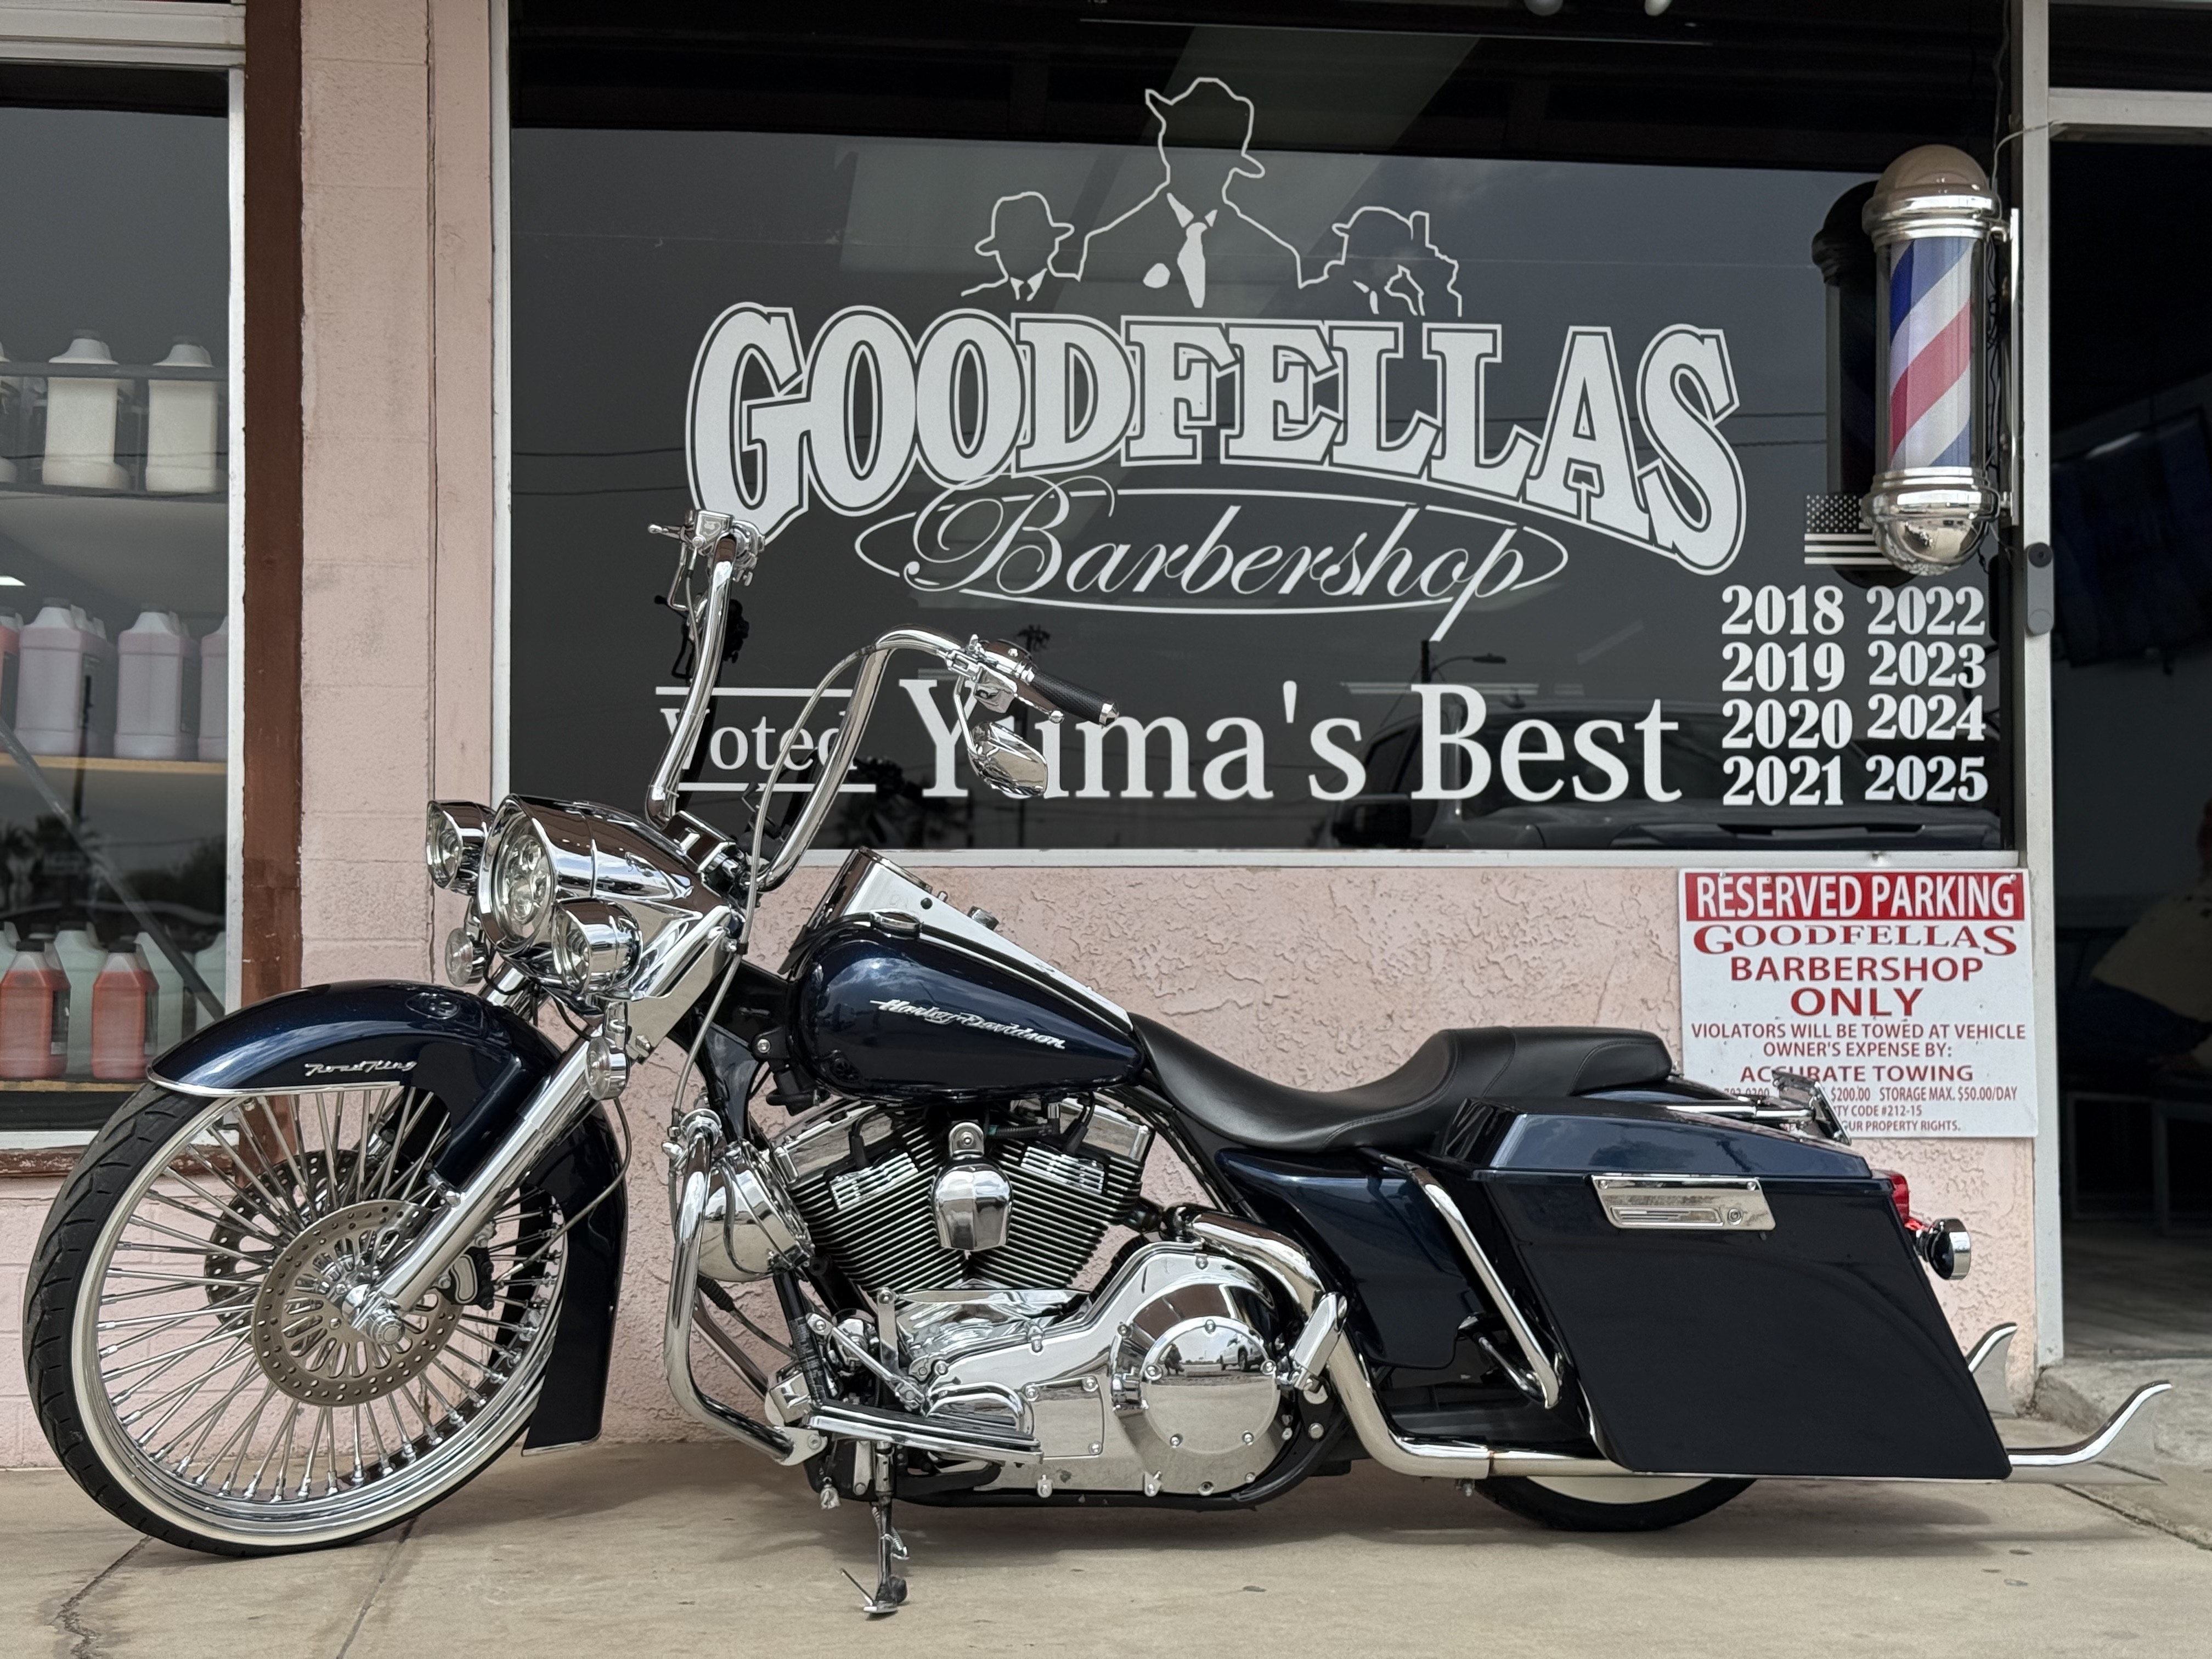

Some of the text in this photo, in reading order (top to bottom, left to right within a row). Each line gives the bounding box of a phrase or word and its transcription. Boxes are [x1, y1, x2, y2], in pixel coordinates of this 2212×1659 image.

[685, 302, 1746, 575] GOODFELLAS
[904, 473, 1524, 641] Barbershop
[1722, 585, 1985, 635] 2018 2022
[1722, 640, 1986, 692] 2019 2023
[1722, 693, 1986, 749] 2020 2024
[1411, 684, 1683, 802] Best
[1723, 754, 1988, 805] 2021 2025
[1697, 874, 2016, 918] RESERVED PARKING
[1693, 924, 2017, 955] GOODFELLAS
[1731, 957, 1983, 981] BARBERSHOP
[1791, 988, 1924, 1017] ONLY
[870, 1000, 1065, 1049] Harley-Davidson
[1691, 1023, 2025, 1039] VIOLATORS WILL BE TOWED AT VEHICLE
[1764, 1042, 1952, 1057] OWNER'S EXPENSE BY:
[1872, 1065, 1973, 1082] TOWING
[1831, 1086, 2017, 1102] $200.00 STORAGE MAX. $50.00/DAY
[1852, 1105, 1878, 1116] CODE
[1882, 1105, 1922, 1117] #212-15
[1866, 1120, 1917, 1132] PROPERTY
[1921, 1120, 1960, 1132] RIGHTS.
